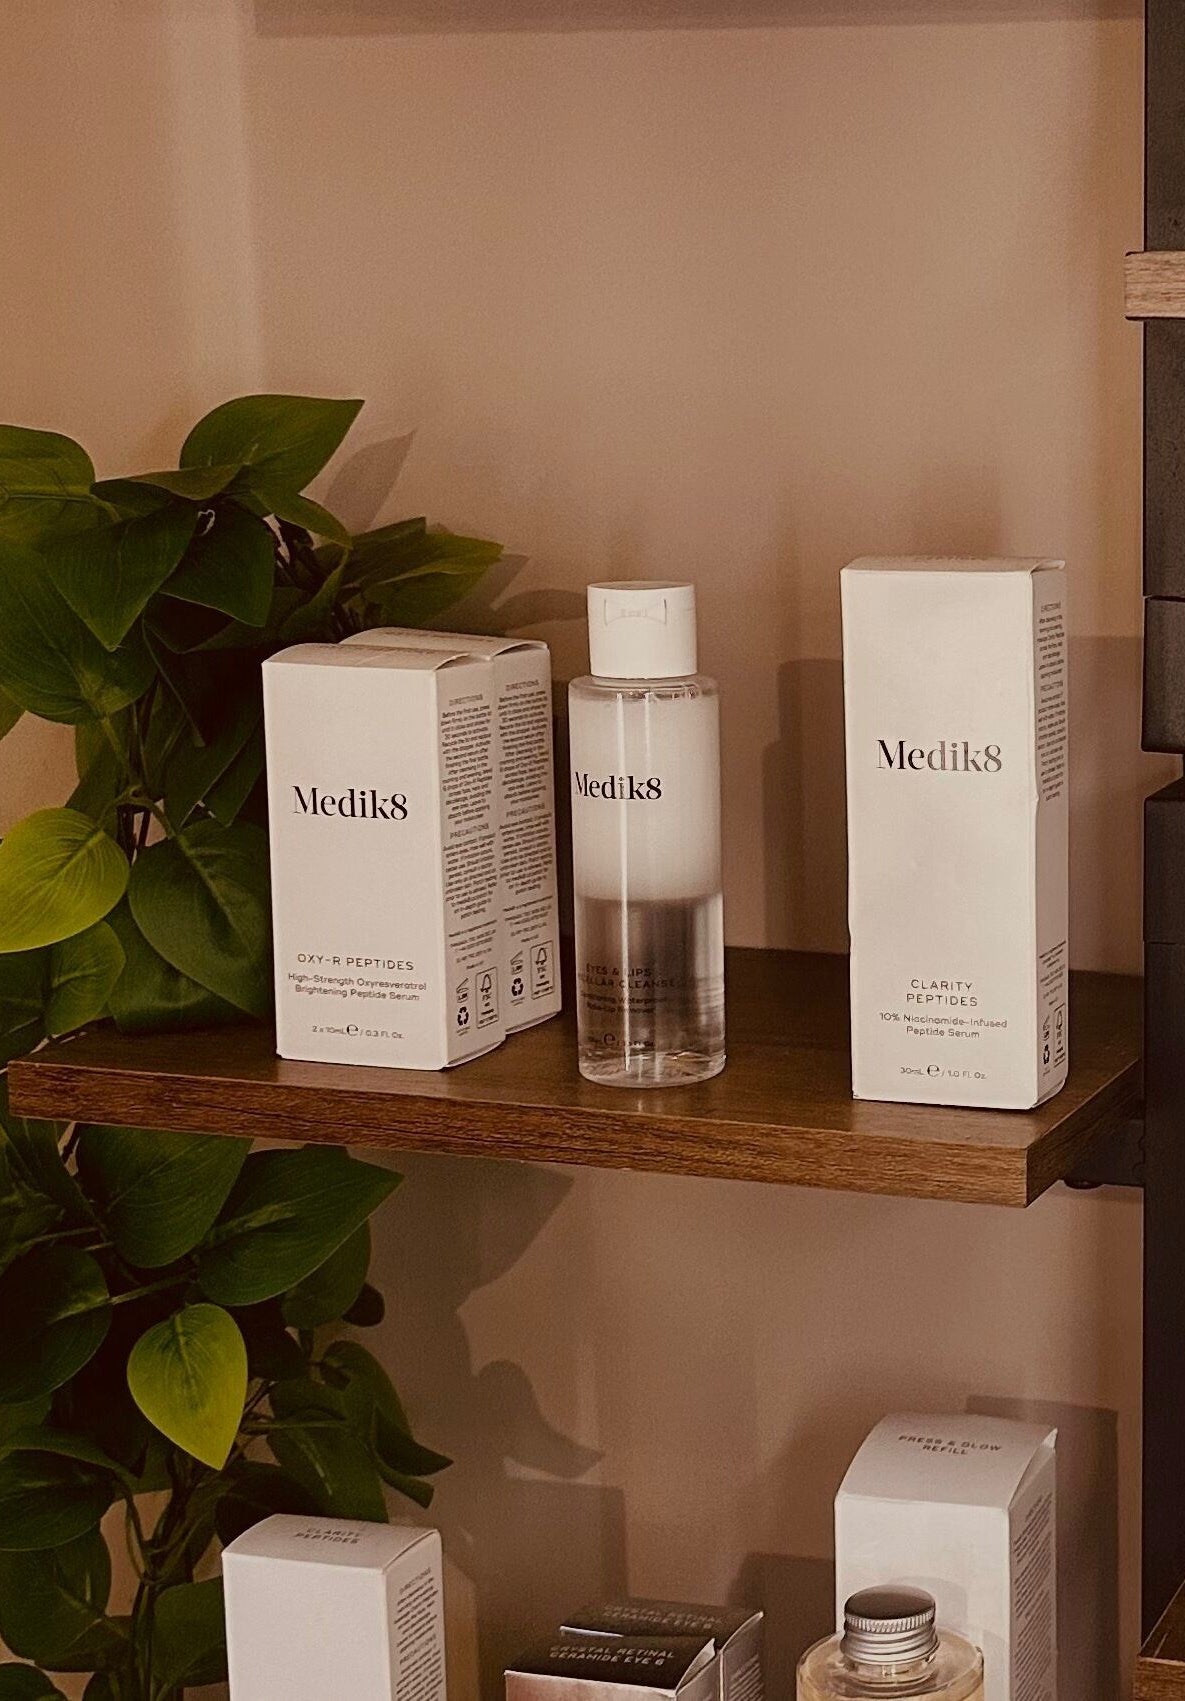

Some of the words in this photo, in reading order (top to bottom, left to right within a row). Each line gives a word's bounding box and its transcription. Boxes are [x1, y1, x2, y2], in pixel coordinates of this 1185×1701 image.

[875, 738, 1003, 773] Medik8
[575, 771, 663, 800] Medik8
[292, 785, 409, 821] Medik8
[297, 953, 341, 966] OXY-R
[346, 957, 415, 971] PEPTIDES
[288, 972, 355, 987] High-Strength
[910, 979, 973, 991] CLARITY
[295, 984, 348, 998] Brightening
[350, 988, 387, 1000] Peptide
[906, 993, 978, 1007] PEPTIDES
[879, 1012, 900, 1022] 10%
[906, 1026, 946, 1037] Peptide
[948, 1028, 980, 1039] Serum
[922, 1444, 969, 1456] REFILL
